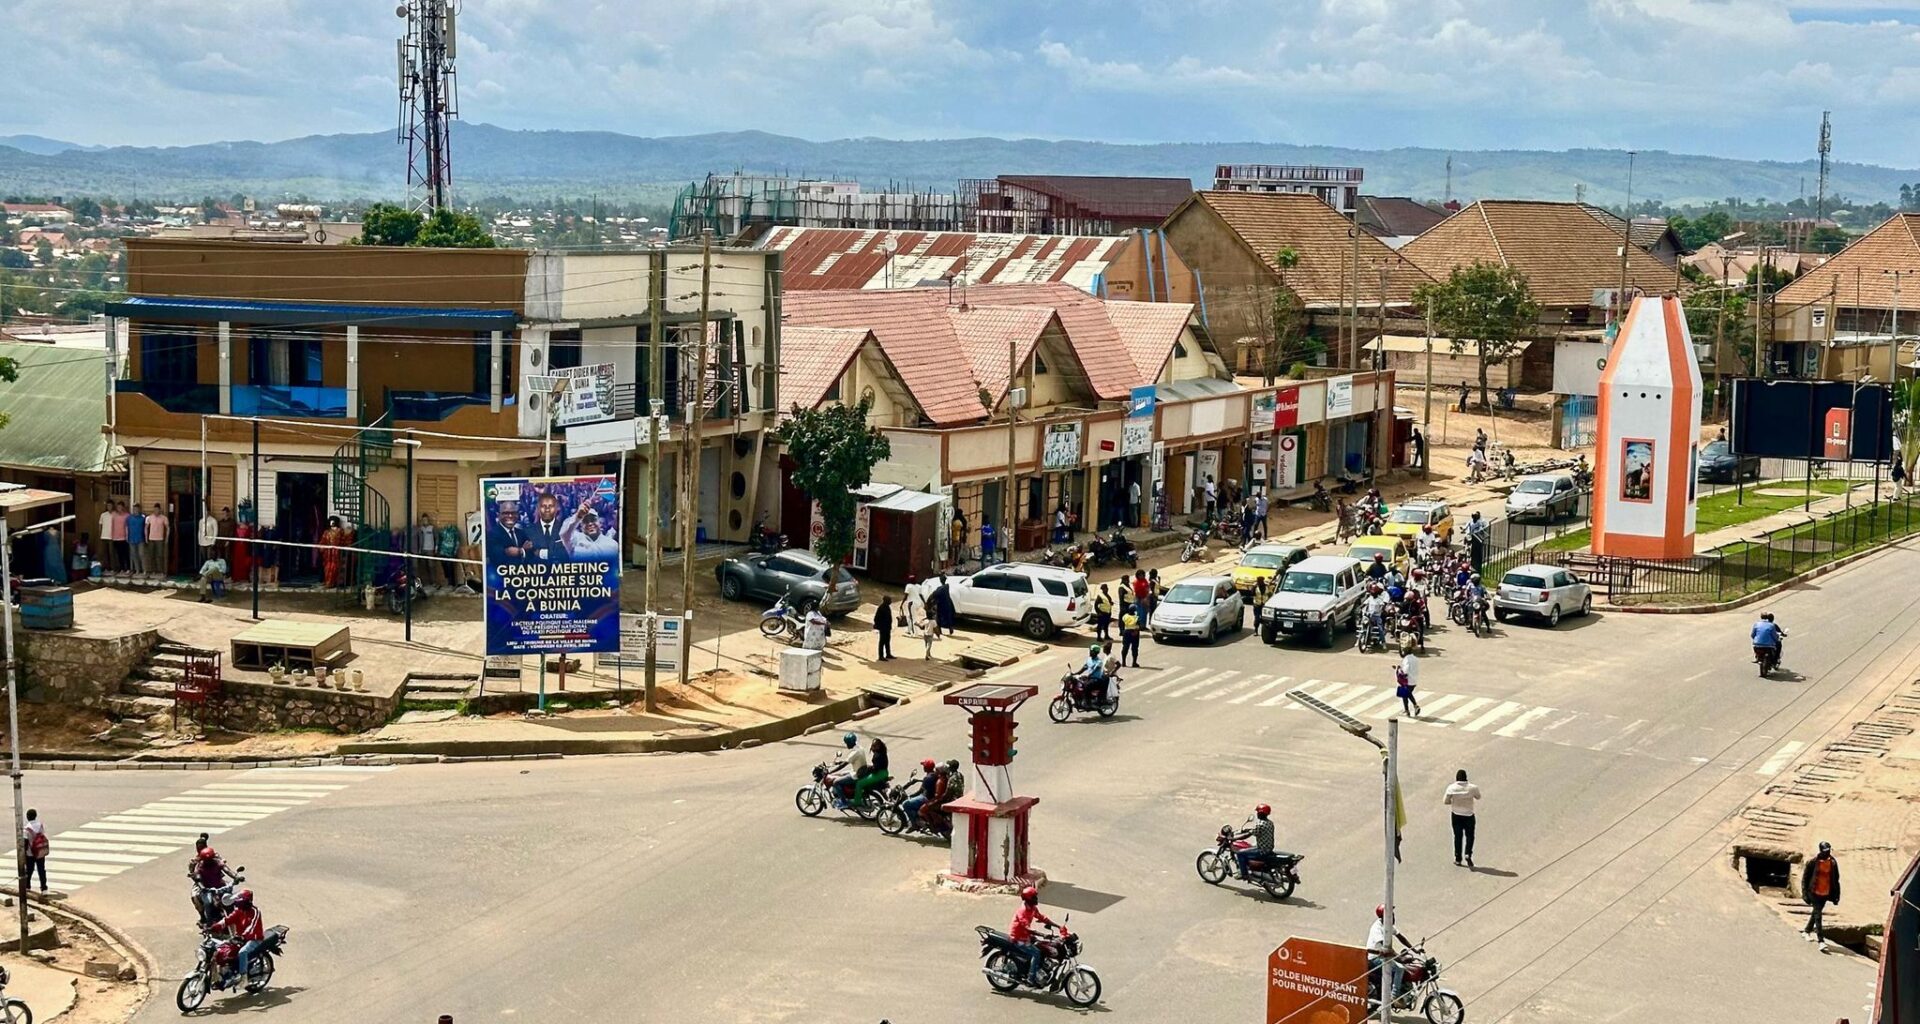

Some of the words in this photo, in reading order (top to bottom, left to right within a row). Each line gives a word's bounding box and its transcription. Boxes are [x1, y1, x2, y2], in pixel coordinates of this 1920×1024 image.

[1280, 454, 1288, 485] vodacom
[496, 564, 547, 576] GRAND
[551, 562, 610, 574] MEETING
[503, 575, 575, 588] POPULAIRE
[579, 574, 603, 586] SUR
[495, 590, 511, 601] LA
[515, 587, 611, 600] CONSTITUTION
[525, 598, 536, 612] À
[540, 600, 581, 611] BUNIA
[1272, 967, 1300, 981] SOLDE
[1301, 975, 1358, 994] INSUFFISANT
[1272, 978, 1296, 990] POUR
[1297, 983, 1324, 996] ENVOI
[1326, 989, 1359, 1005] ARGENT
[1360, 997, 1366, 1006] ?
